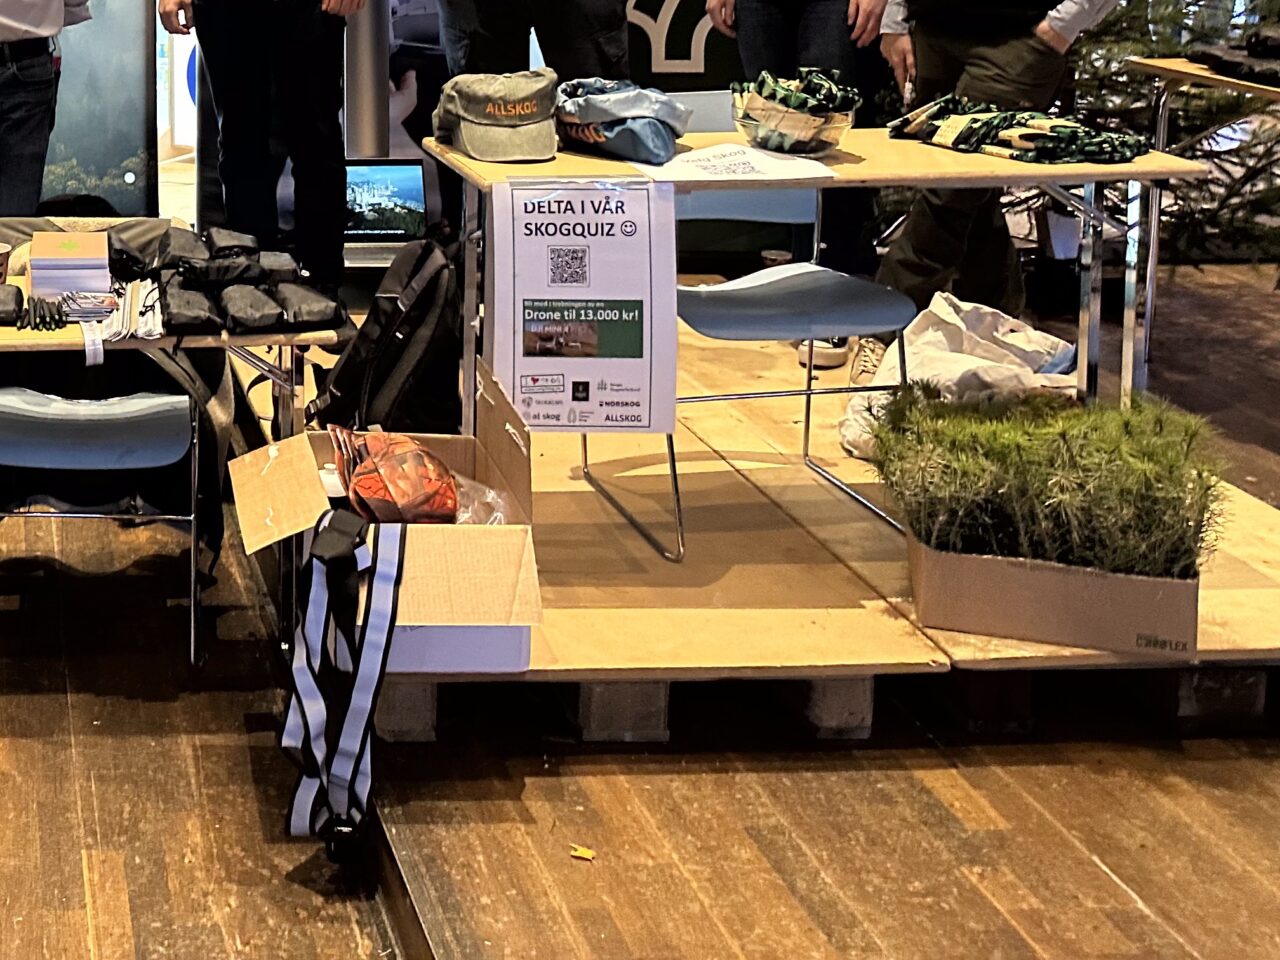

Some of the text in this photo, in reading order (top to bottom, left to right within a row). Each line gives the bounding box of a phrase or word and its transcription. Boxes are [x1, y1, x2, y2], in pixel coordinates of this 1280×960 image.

[485, 101, 537, 117] ALLSKOG
[524, 196, 625, 214] DELTA I VÅR
[524, 222, 615, 238] SKOGQUIZ
[525, 309, 638, 321] Drone til 13.000 kr!
[604, 414, 642, 422] ALLSKOG
